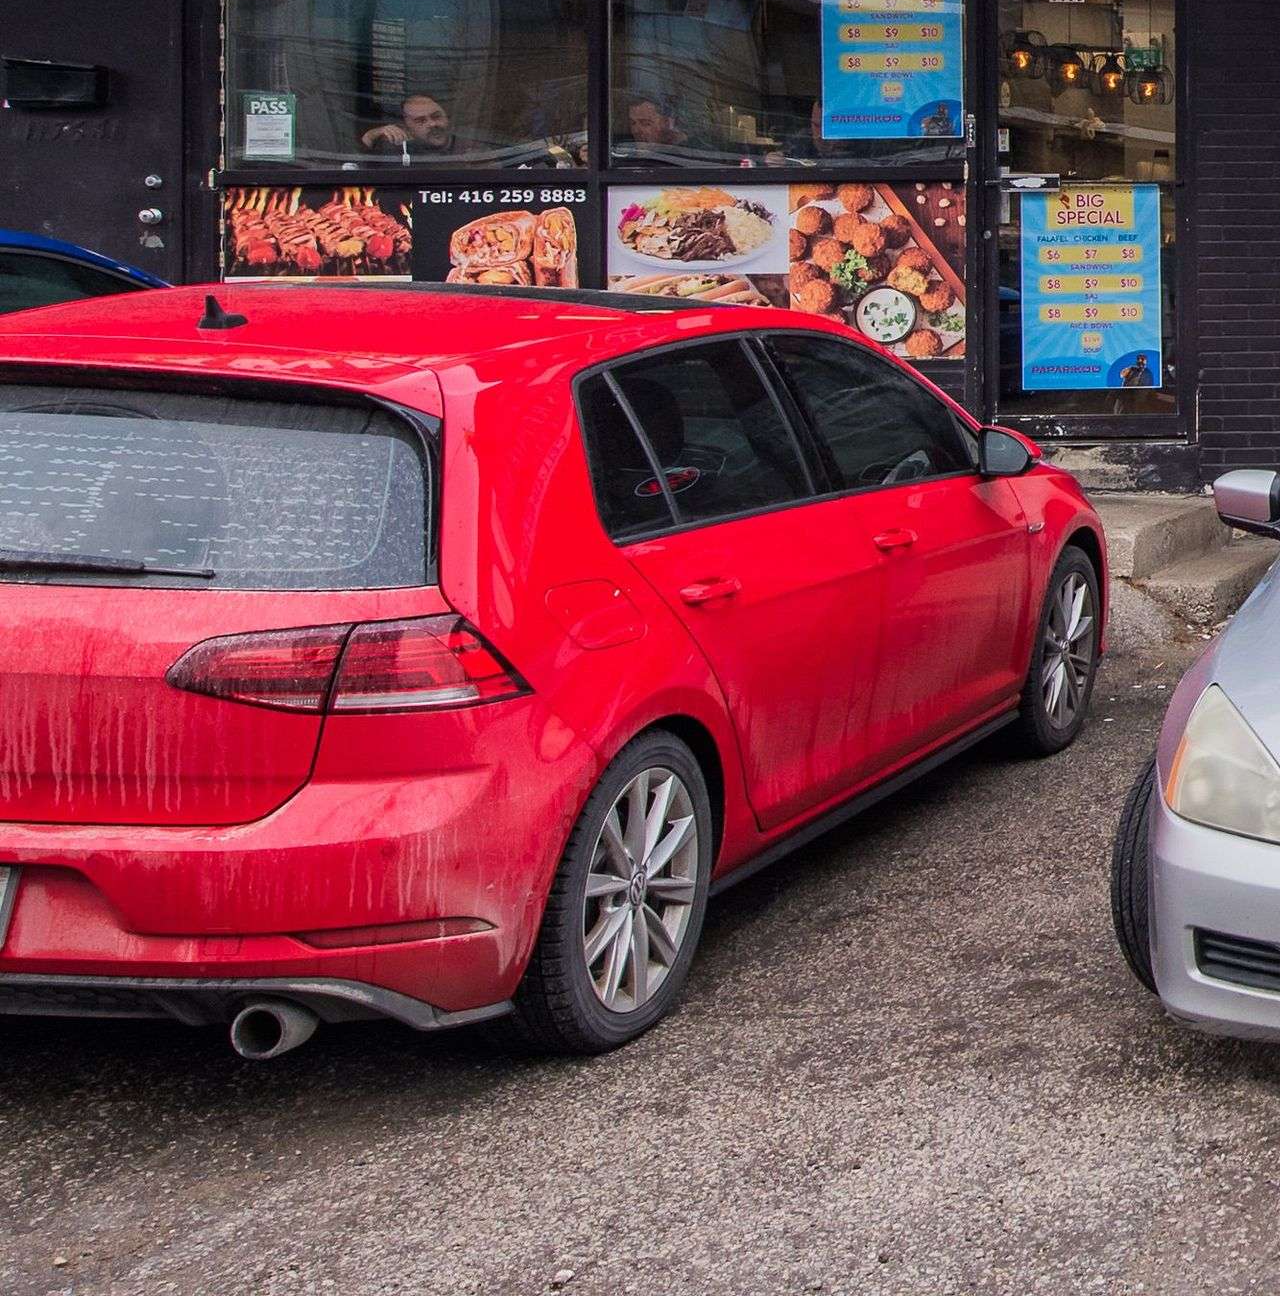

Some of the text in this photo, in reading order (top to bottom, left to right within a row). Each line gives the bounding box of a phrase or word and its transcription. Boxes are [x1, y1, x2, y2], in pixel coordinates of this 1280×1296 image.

[847, 27, 938, 39] $8 $9 $10
[848, 56, 938, 68] $8 $9 $10
[250, 101, 288, 114] PASS
[418, 189, 586, 204] Tel: 416 259 8883
[1076, 194, 1104, 208] BIG
[1057, 211, 1125, 224] SPECIAL
[1047, 248, 1135, 260] $6 $7 $8
[1047, 278, 1138, 289] $8 $9 $10
[1047, 307, 1138, 319] $8 $9 $10
